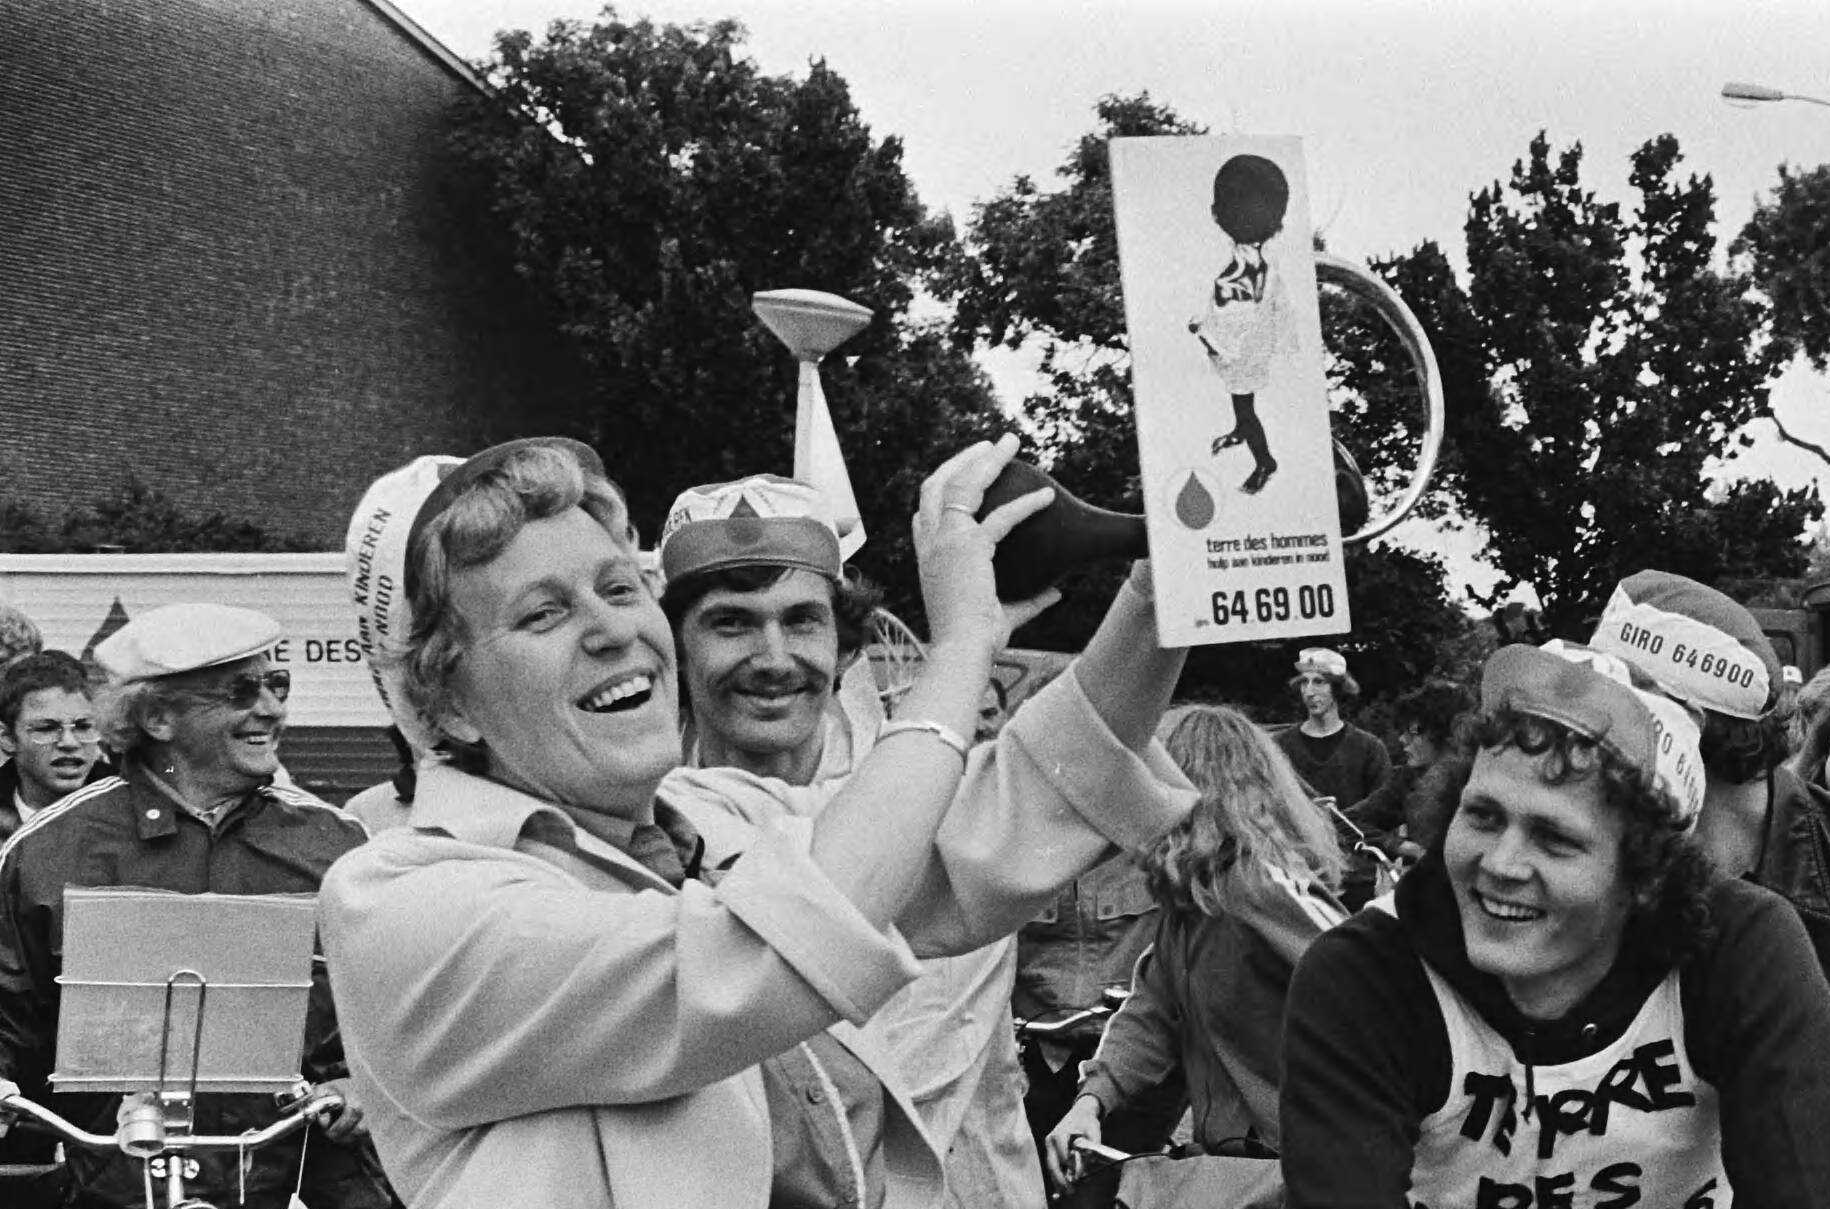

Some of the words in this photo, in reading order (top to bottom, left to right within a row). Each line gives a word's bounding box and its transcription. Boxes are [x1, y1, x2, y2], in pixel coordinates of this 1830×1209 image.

[355, 507, 392, 606] KINDEREN
[1207, 538, 1241, 553] terre
[1244, 533, 1268, 551] des
[1270, 532, 1329, 549] hommes
[375, 575, 394, 637] NOOD
[305, 639, 361, 663] DES
[1620, 622, 1664, 655] GIRO
[1672, 644, 1754, 688] 646900
